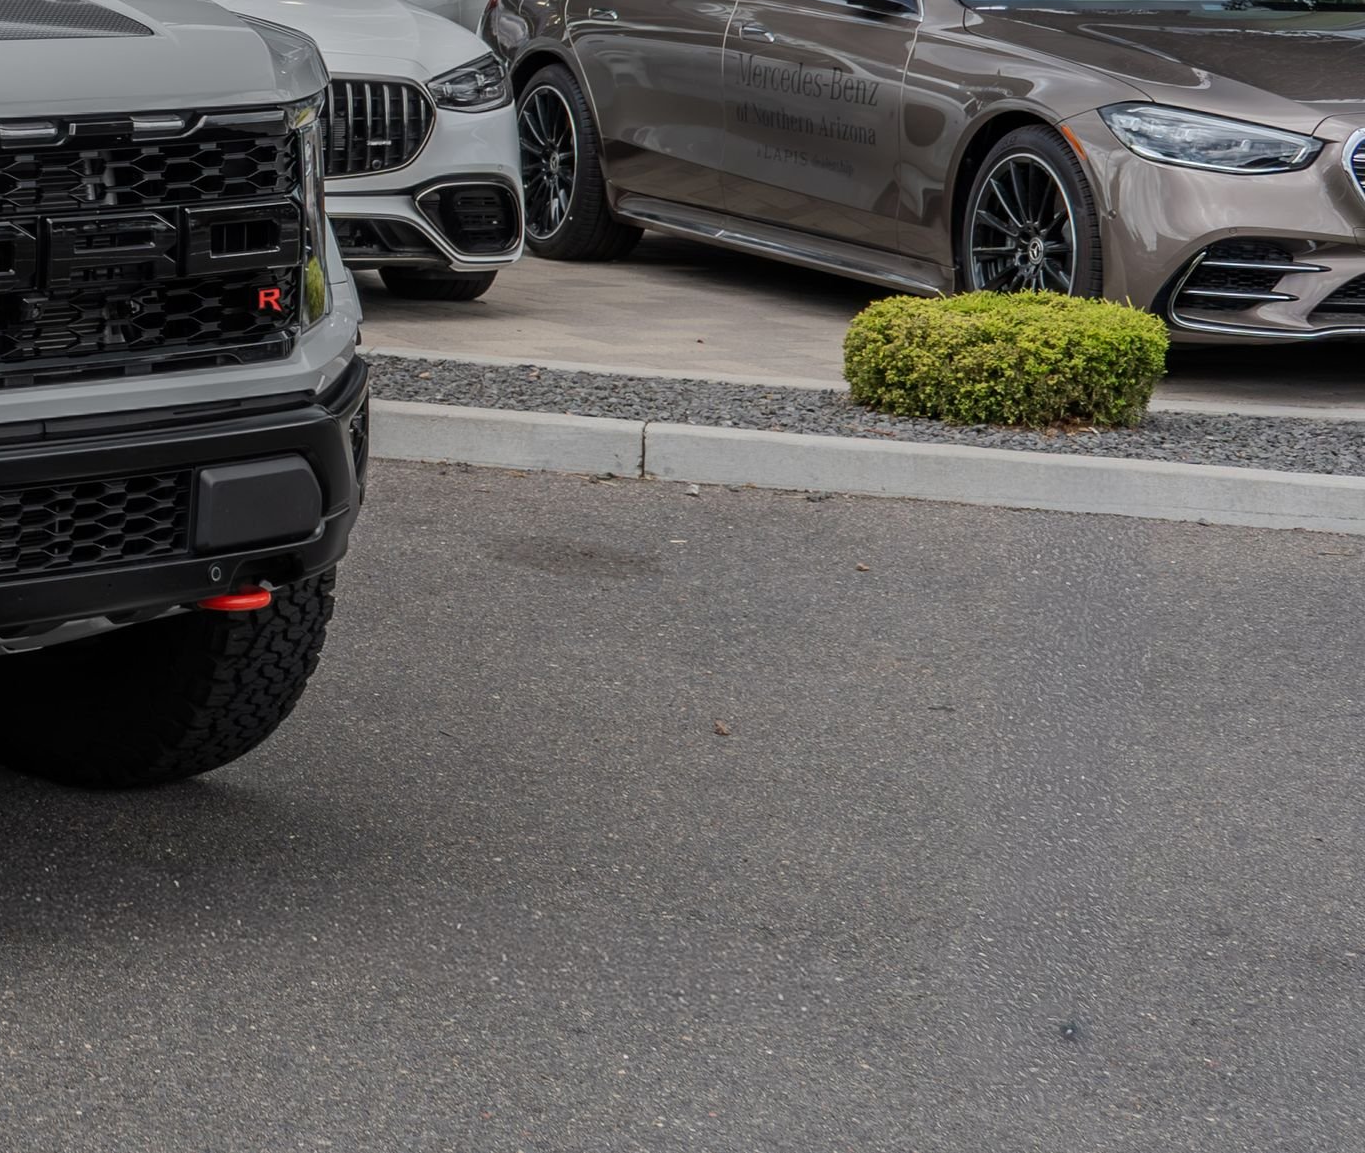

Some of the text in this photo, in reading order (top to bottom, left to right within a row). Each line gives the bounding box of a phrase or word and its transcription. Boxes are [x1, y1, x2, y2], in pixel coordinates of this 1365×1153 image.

[736, 53, 880, 107] Mercedes-Benz
[735, 101, 877, 146] of Northern Arizona
[764, 144, 808, 166] LAPIS
[258, 288, 282, 311] R
